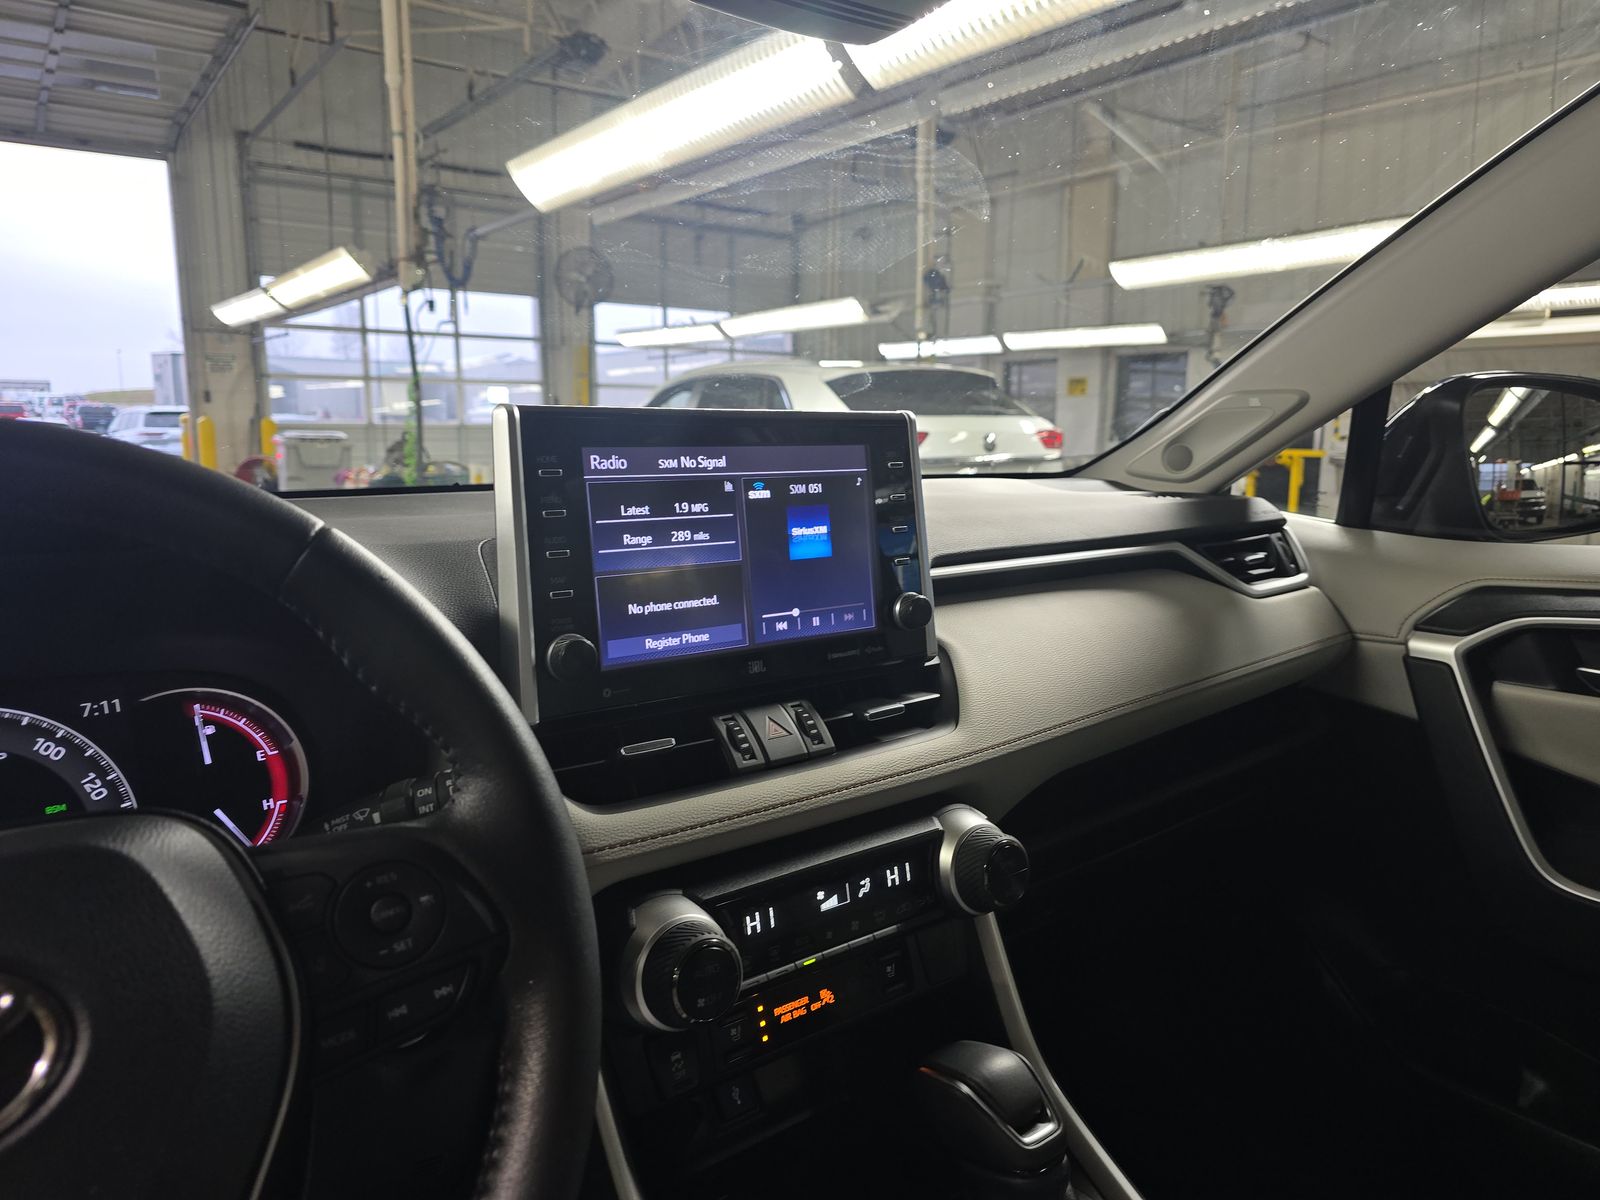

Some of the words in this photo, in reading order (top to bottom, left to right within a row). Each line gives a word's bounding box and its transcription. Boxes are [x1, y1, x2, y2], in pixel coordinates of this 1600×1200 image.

[590, 455, 627, 469] Radio
[658, 459, 678, 468] SXM
[680, 456, 696, 468] No
[697, 456, 726, 470] Signal
[789, 484, 806, 494] SXM
[808, 483, 822, 493] 051
[620, 504, 650, 516] Latest
[674, 502, 689, 513] 1.9
[691, 502, 709, 512] MPG
[623, 533, 653, 545] Range
[671, 530, 691, 542] 289
[693, 531, 710, 541] miles
[791, 525, 828, 536] SiriusXM
[628, 603, 643, 615] No
[644, 601, 672, 615] phone
[673, 594, 720, 610] connected.
[645, 637, 682, 650] Register
[682, 632, 710, 644] Phone
[80, 699, 121, 718] 7:11
[33, 737, 66, 761] 100
[256, 749, 267, 761] E
[81, 772, 108, 801] 120
[416, 786, 433, 797] ON
[262, 798, 275, 810] H
[418, 803, 435, 815] INT
[886, 862, 911, 888] HI
[745, 906, 776, 936] HI
[774, 996, 809, 1016] PASSENGER
